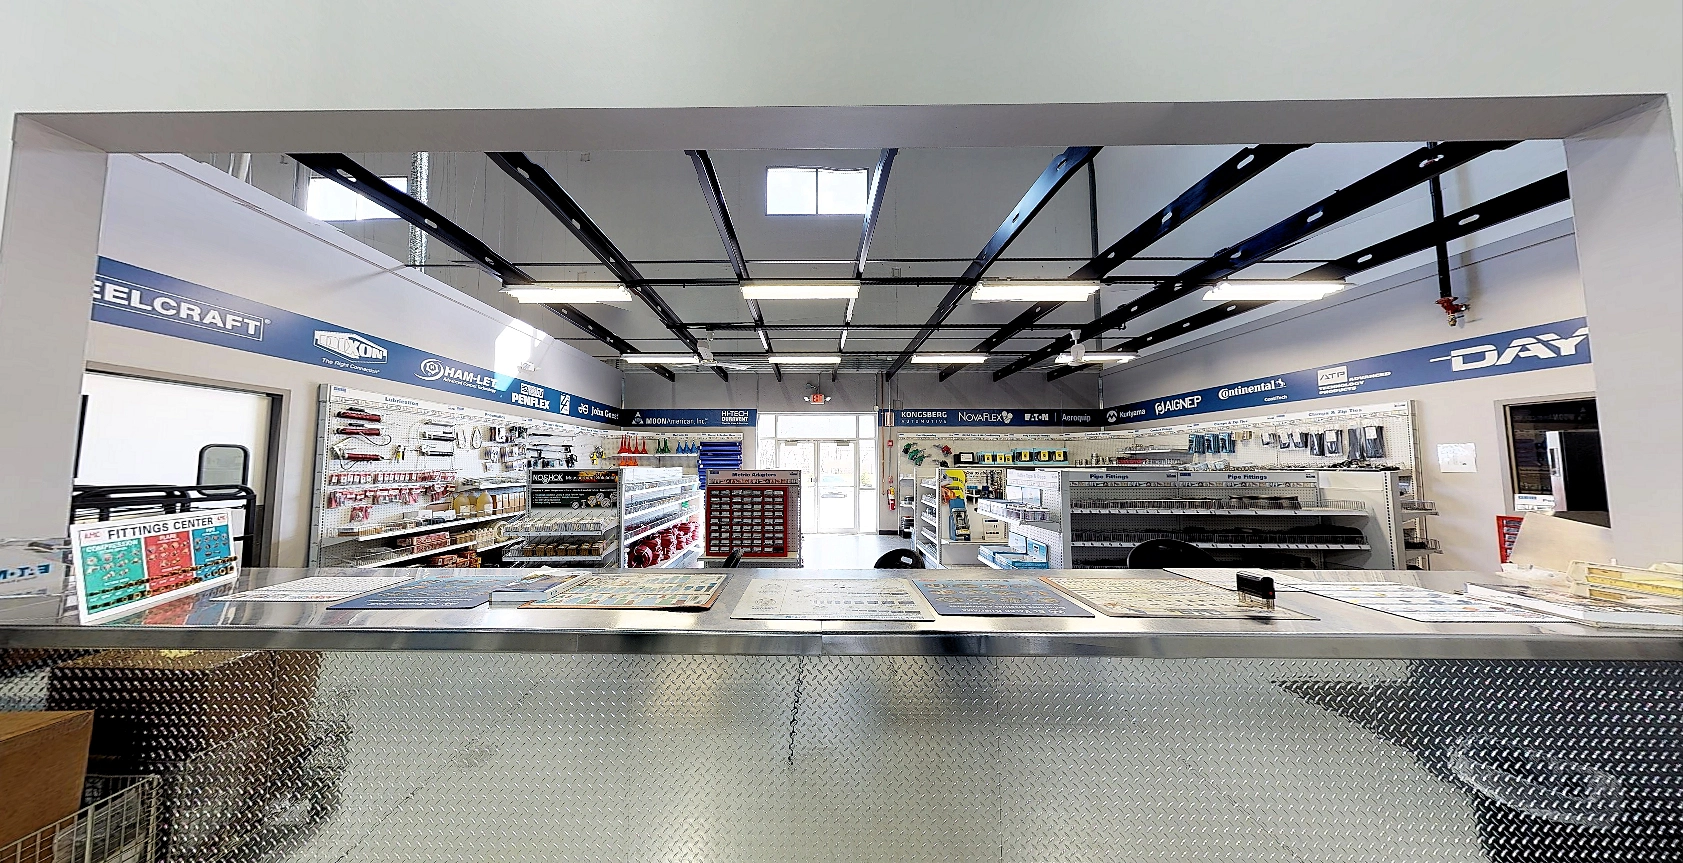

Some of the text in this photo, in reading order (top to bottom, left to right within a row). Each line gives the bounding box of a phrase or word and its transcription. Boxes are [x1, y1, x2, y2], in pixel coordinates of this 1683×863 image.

[319, 333, 384, 359] DIXON
[1450, 327, 1589, 372] DAY
[444, 366, 498, 388] HAM-LET
[1320, 371, 1346, 381] ATP
[1218, 380, 1276, 400] Continental
[385, 396, 419, 406] Lubrication
[512, 393, 551, 410] PENFLEX
[1164, 396, 1202, 412] AIGNEP
[1062, 413, 1091, 423] Aeroquip
[532, 473, 564, 482] NOSHOK
[108, 523, 169, 540] FITTINGS
[174, 517, 214, 530] CENTER
